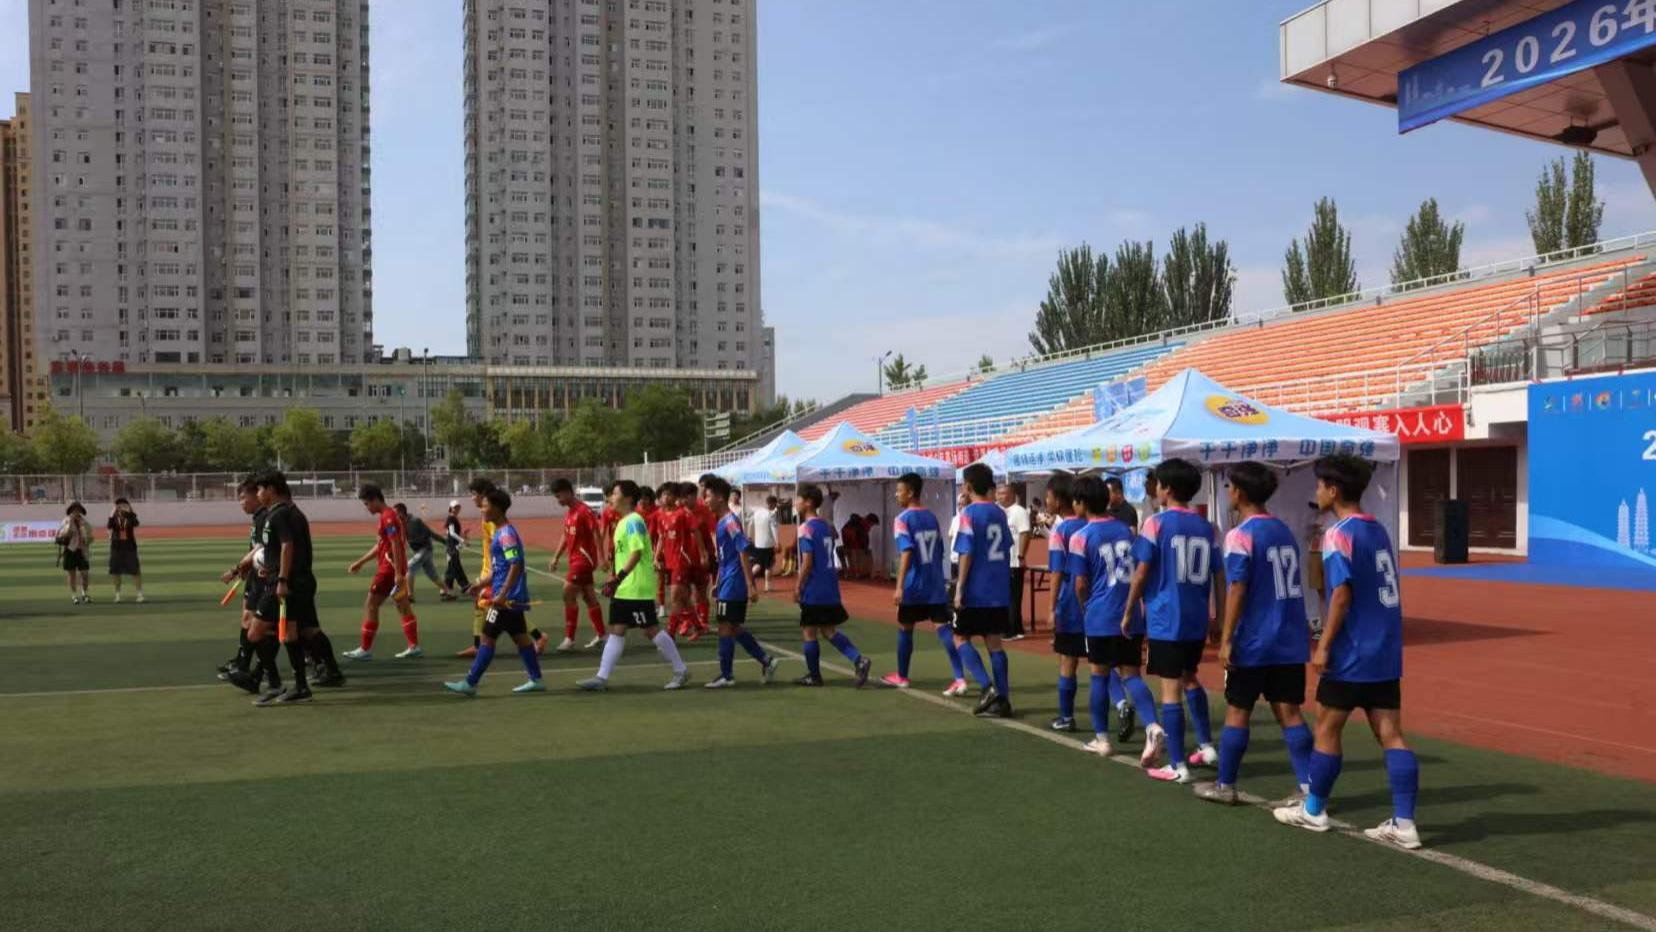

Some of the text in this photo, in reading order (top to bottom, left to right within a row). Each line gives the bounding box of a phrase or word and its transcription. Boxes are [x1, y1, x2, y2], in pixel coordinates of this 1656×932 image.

[1479, 0, 1656, 90] 2026年
[914, 530, 938, 564] 17
[986, 523, 1005, 562] 2
[1171, 535, 1211, 586] 10
[1267, 545, 1303, 600] 12
[1376, 549, 1400, 608] 3
